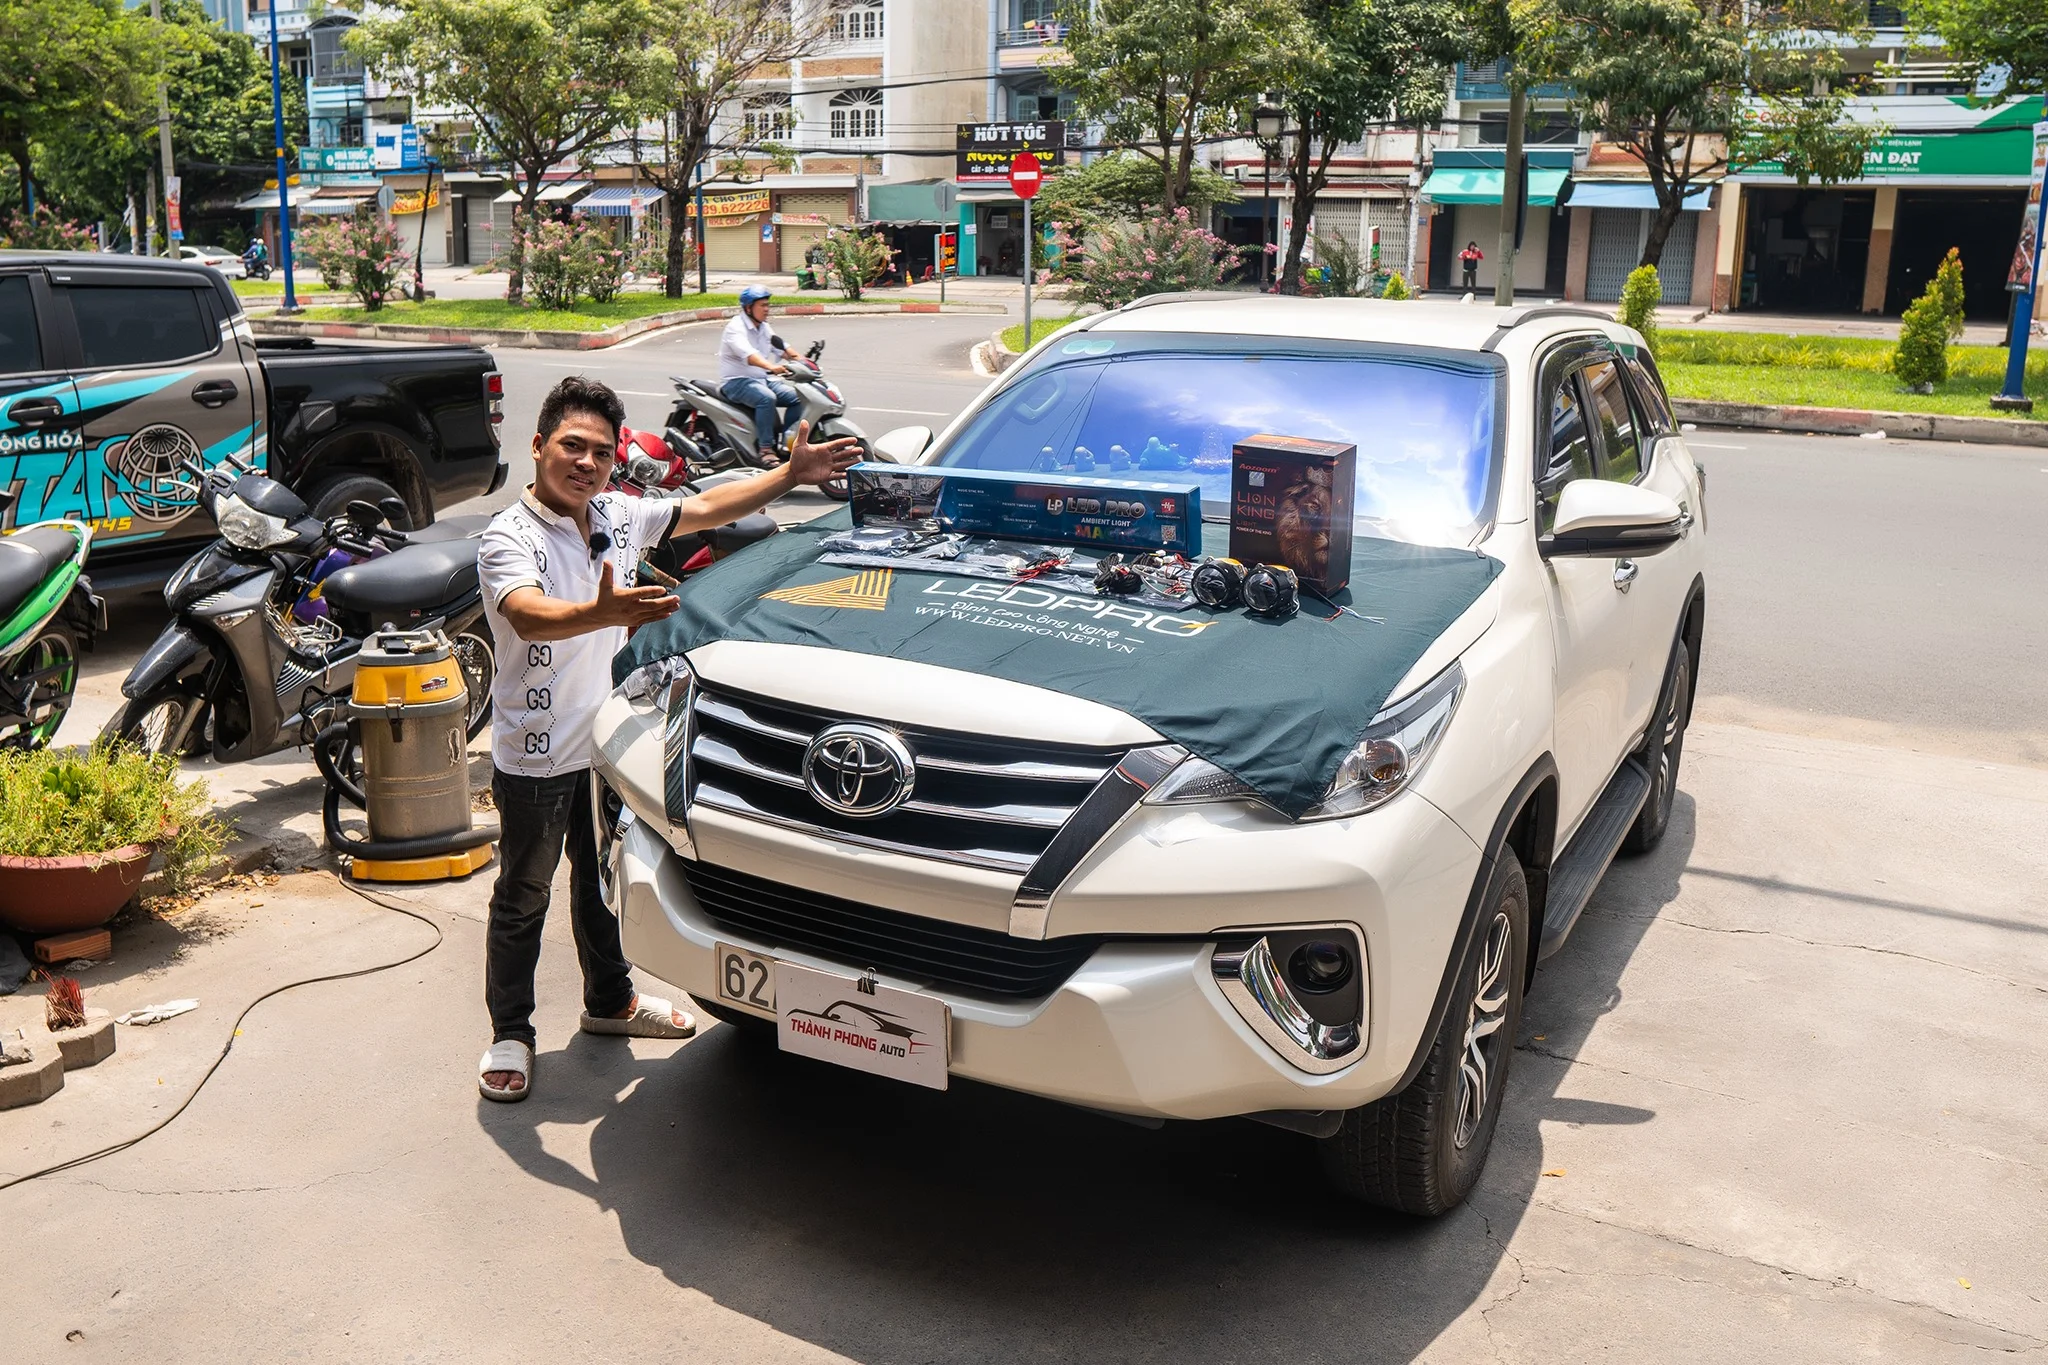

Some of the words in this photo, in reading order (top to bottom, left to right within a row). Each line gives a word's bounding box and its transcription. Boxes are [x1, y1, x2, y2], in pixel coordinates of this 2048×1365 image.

[1013, 123, 1046, 141] TÓC
[1887, 151, 1922, 168] ĐẠT
[45, 429, 83, 448] HÓA
[1066, 498, 1101, 514] LED
[1104, 500, 1146, 518] PRO
[1237, 491, 1276, 507] LION
[1081, 517, 1109, 526] AMBIENT
[1111, 519, 1131, 527] LIGHT
[1236, 505, 1275, 520] KING
[922, 580, 1219, 637] LEDPRO
[915, 605, 1137, 655] WWW.LEDPRO.NET.VN
[992, 608, 1024, 618] Cao
[1071, 623, 1120, 640] Nghệ
[790, 1018, 831, 1041] THÀNH
[833, 1029, 877, 1051] PHONG
[879, 1043, 906, 1058] AUTO
